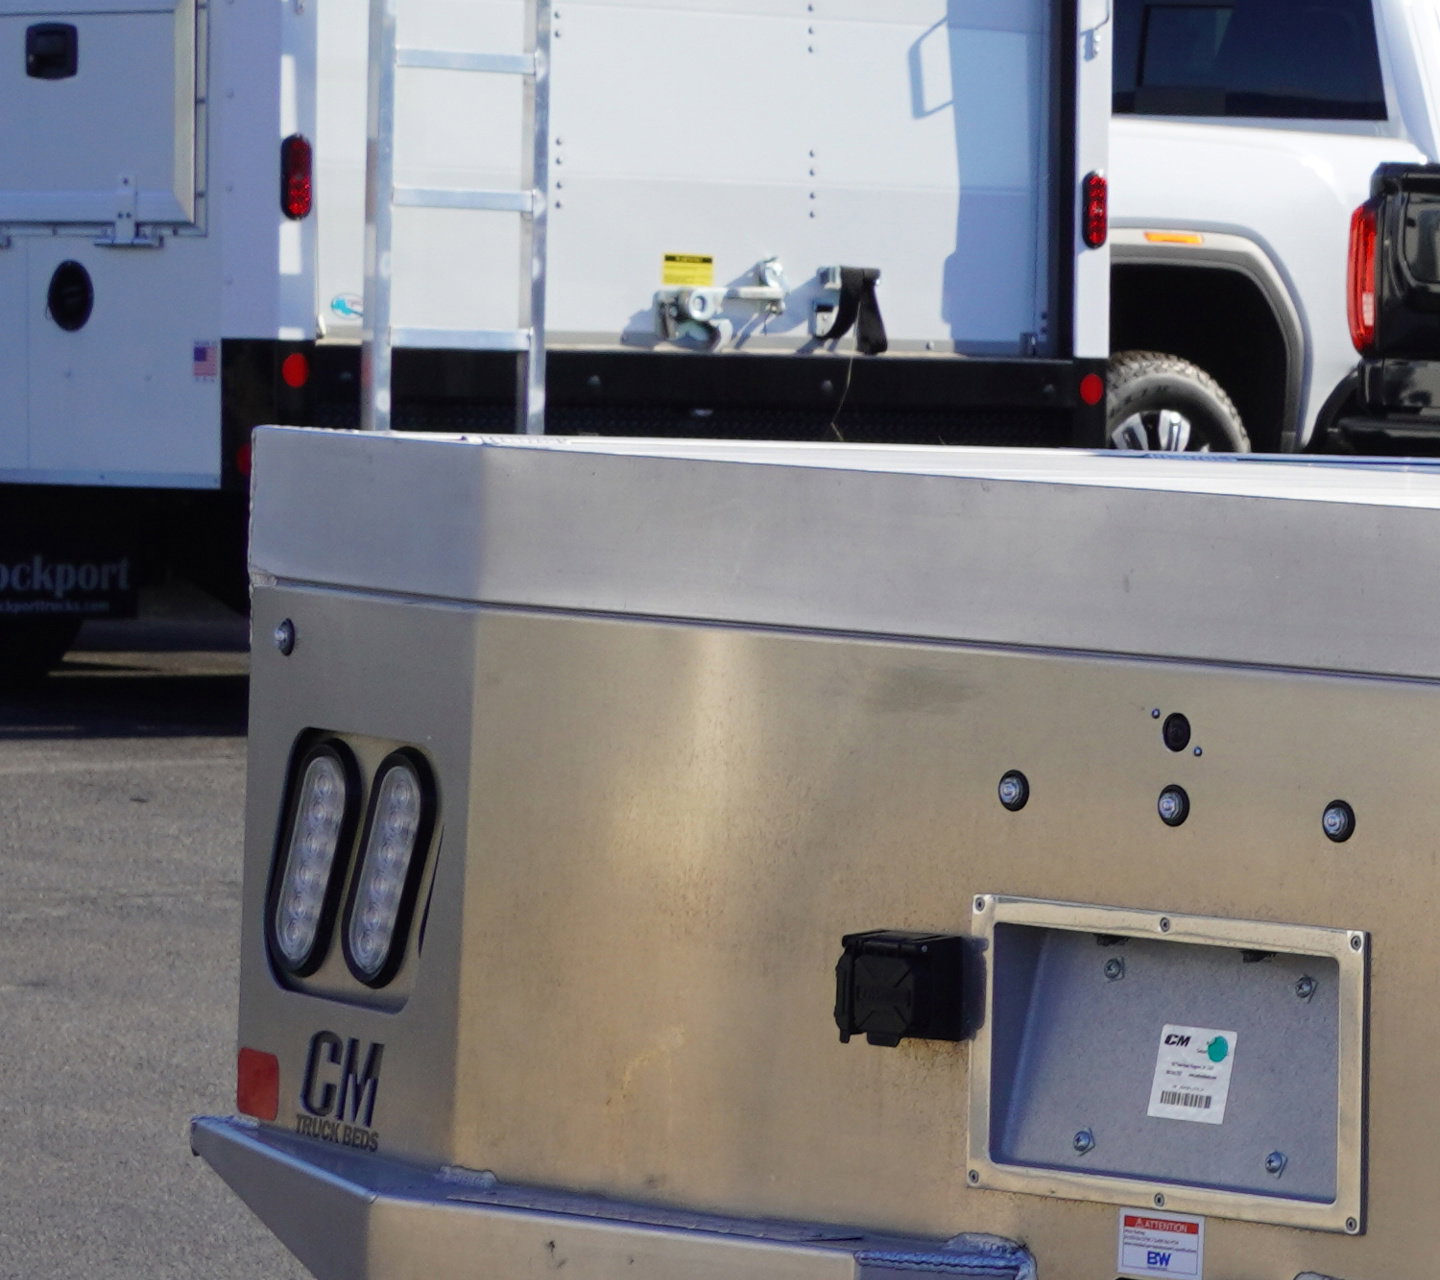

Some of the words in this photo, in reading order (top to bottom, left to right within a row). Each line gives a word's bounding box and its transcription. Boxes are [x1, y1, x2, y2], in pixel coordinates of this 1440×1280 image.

[1164, 1033, 1192, 1048] CM
[301, 1030, 385, 1129] CM
[296, 1113, 340, 1144] TRUCK
[342, 1124, 380, 1153] BEDS
[1144, 1219, 1188, 1233] ATTENTION
